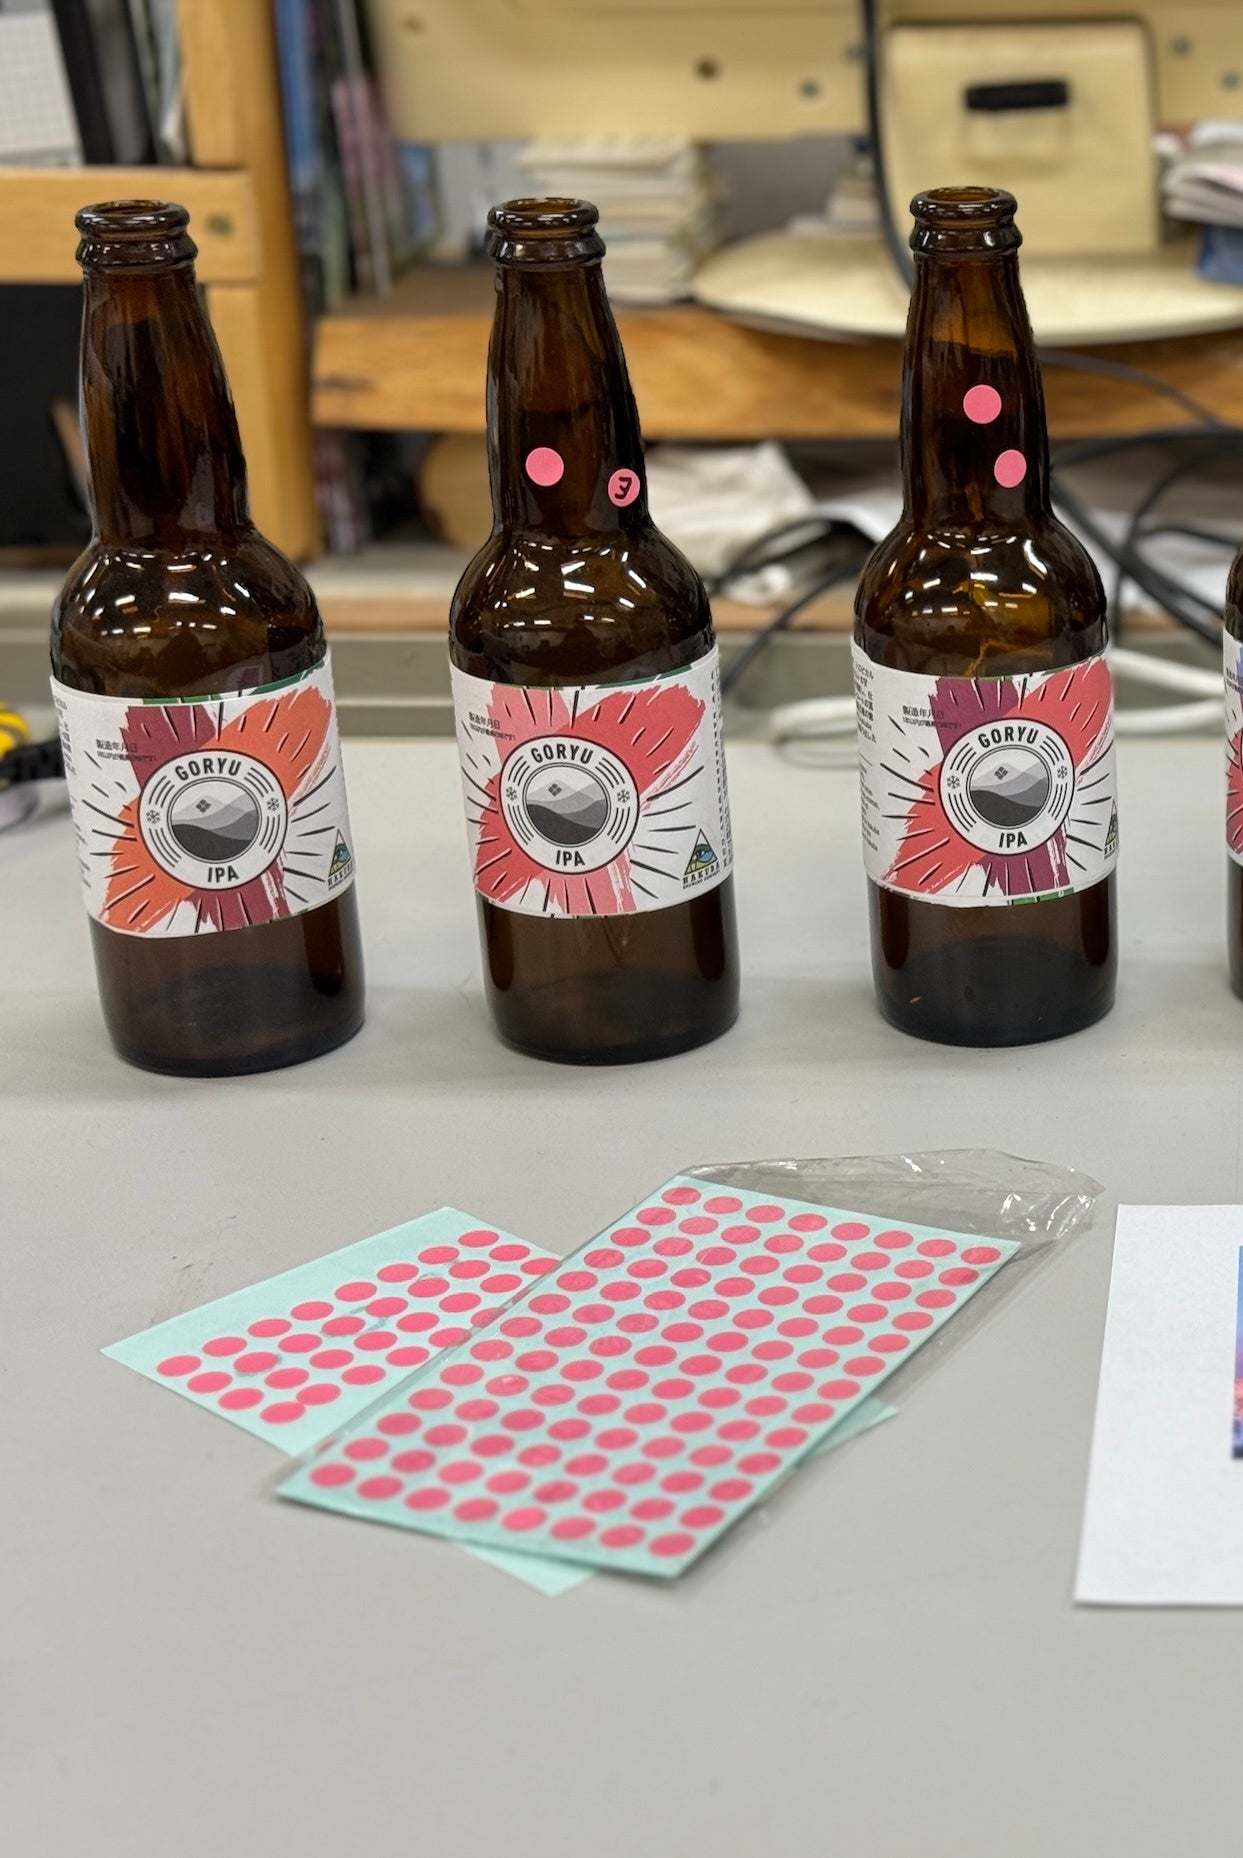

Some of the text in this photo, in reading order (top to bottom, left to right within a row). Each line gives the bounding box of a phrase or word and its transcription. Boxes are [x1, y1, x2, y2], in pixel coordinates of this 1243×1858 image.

[978, 726, 1040, 748] GORYU
[531, 743, 594, 764] GORYU
[175, 759, 243, 781] GORYU
[998, 831, 1028, 849] IPA
[555, 850, 586, 868] IPA
[207, 865, 240, 883] IPA
